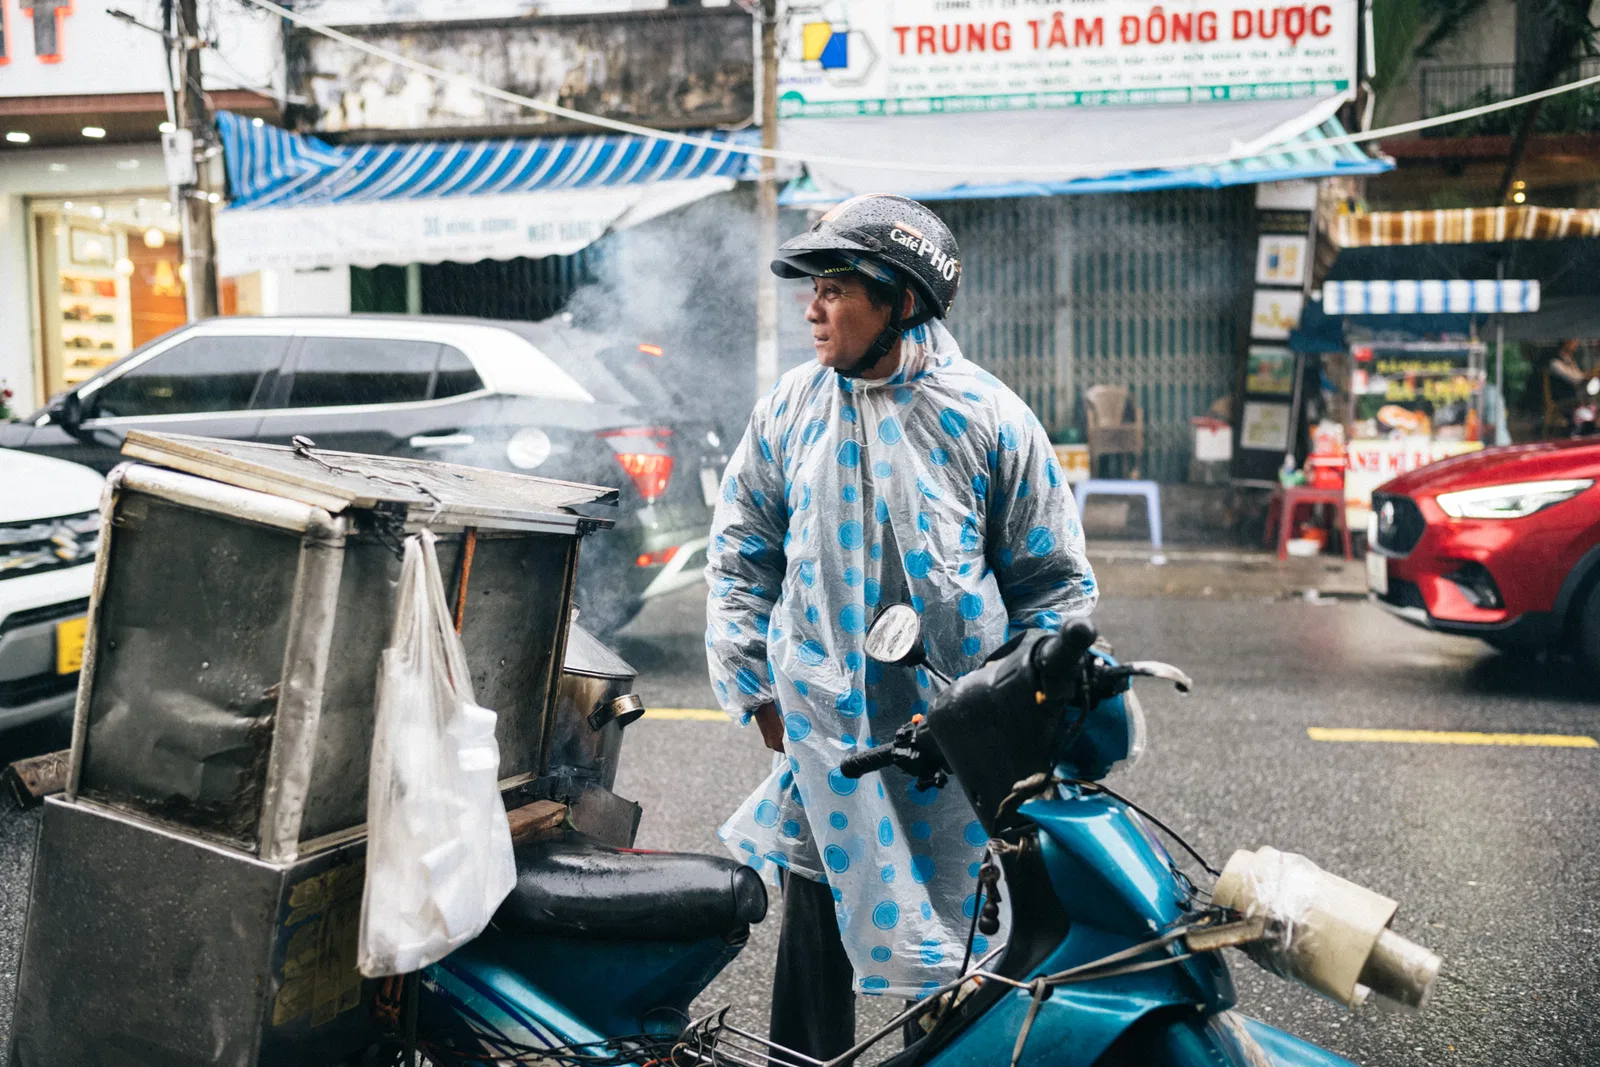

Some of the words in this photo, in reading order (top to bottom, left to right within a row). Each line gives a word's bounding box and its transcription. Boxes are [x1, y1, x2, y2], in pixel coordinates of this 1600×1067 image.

[893, 21, 1011, 55] TRUNG
[1027, 11, 1103, 49] TÂM
[1120, 6, 1217, 46] ĐÔNG
[890, 228, 920, 251] Café
[824, 266, 854, 274] ARTENGO
